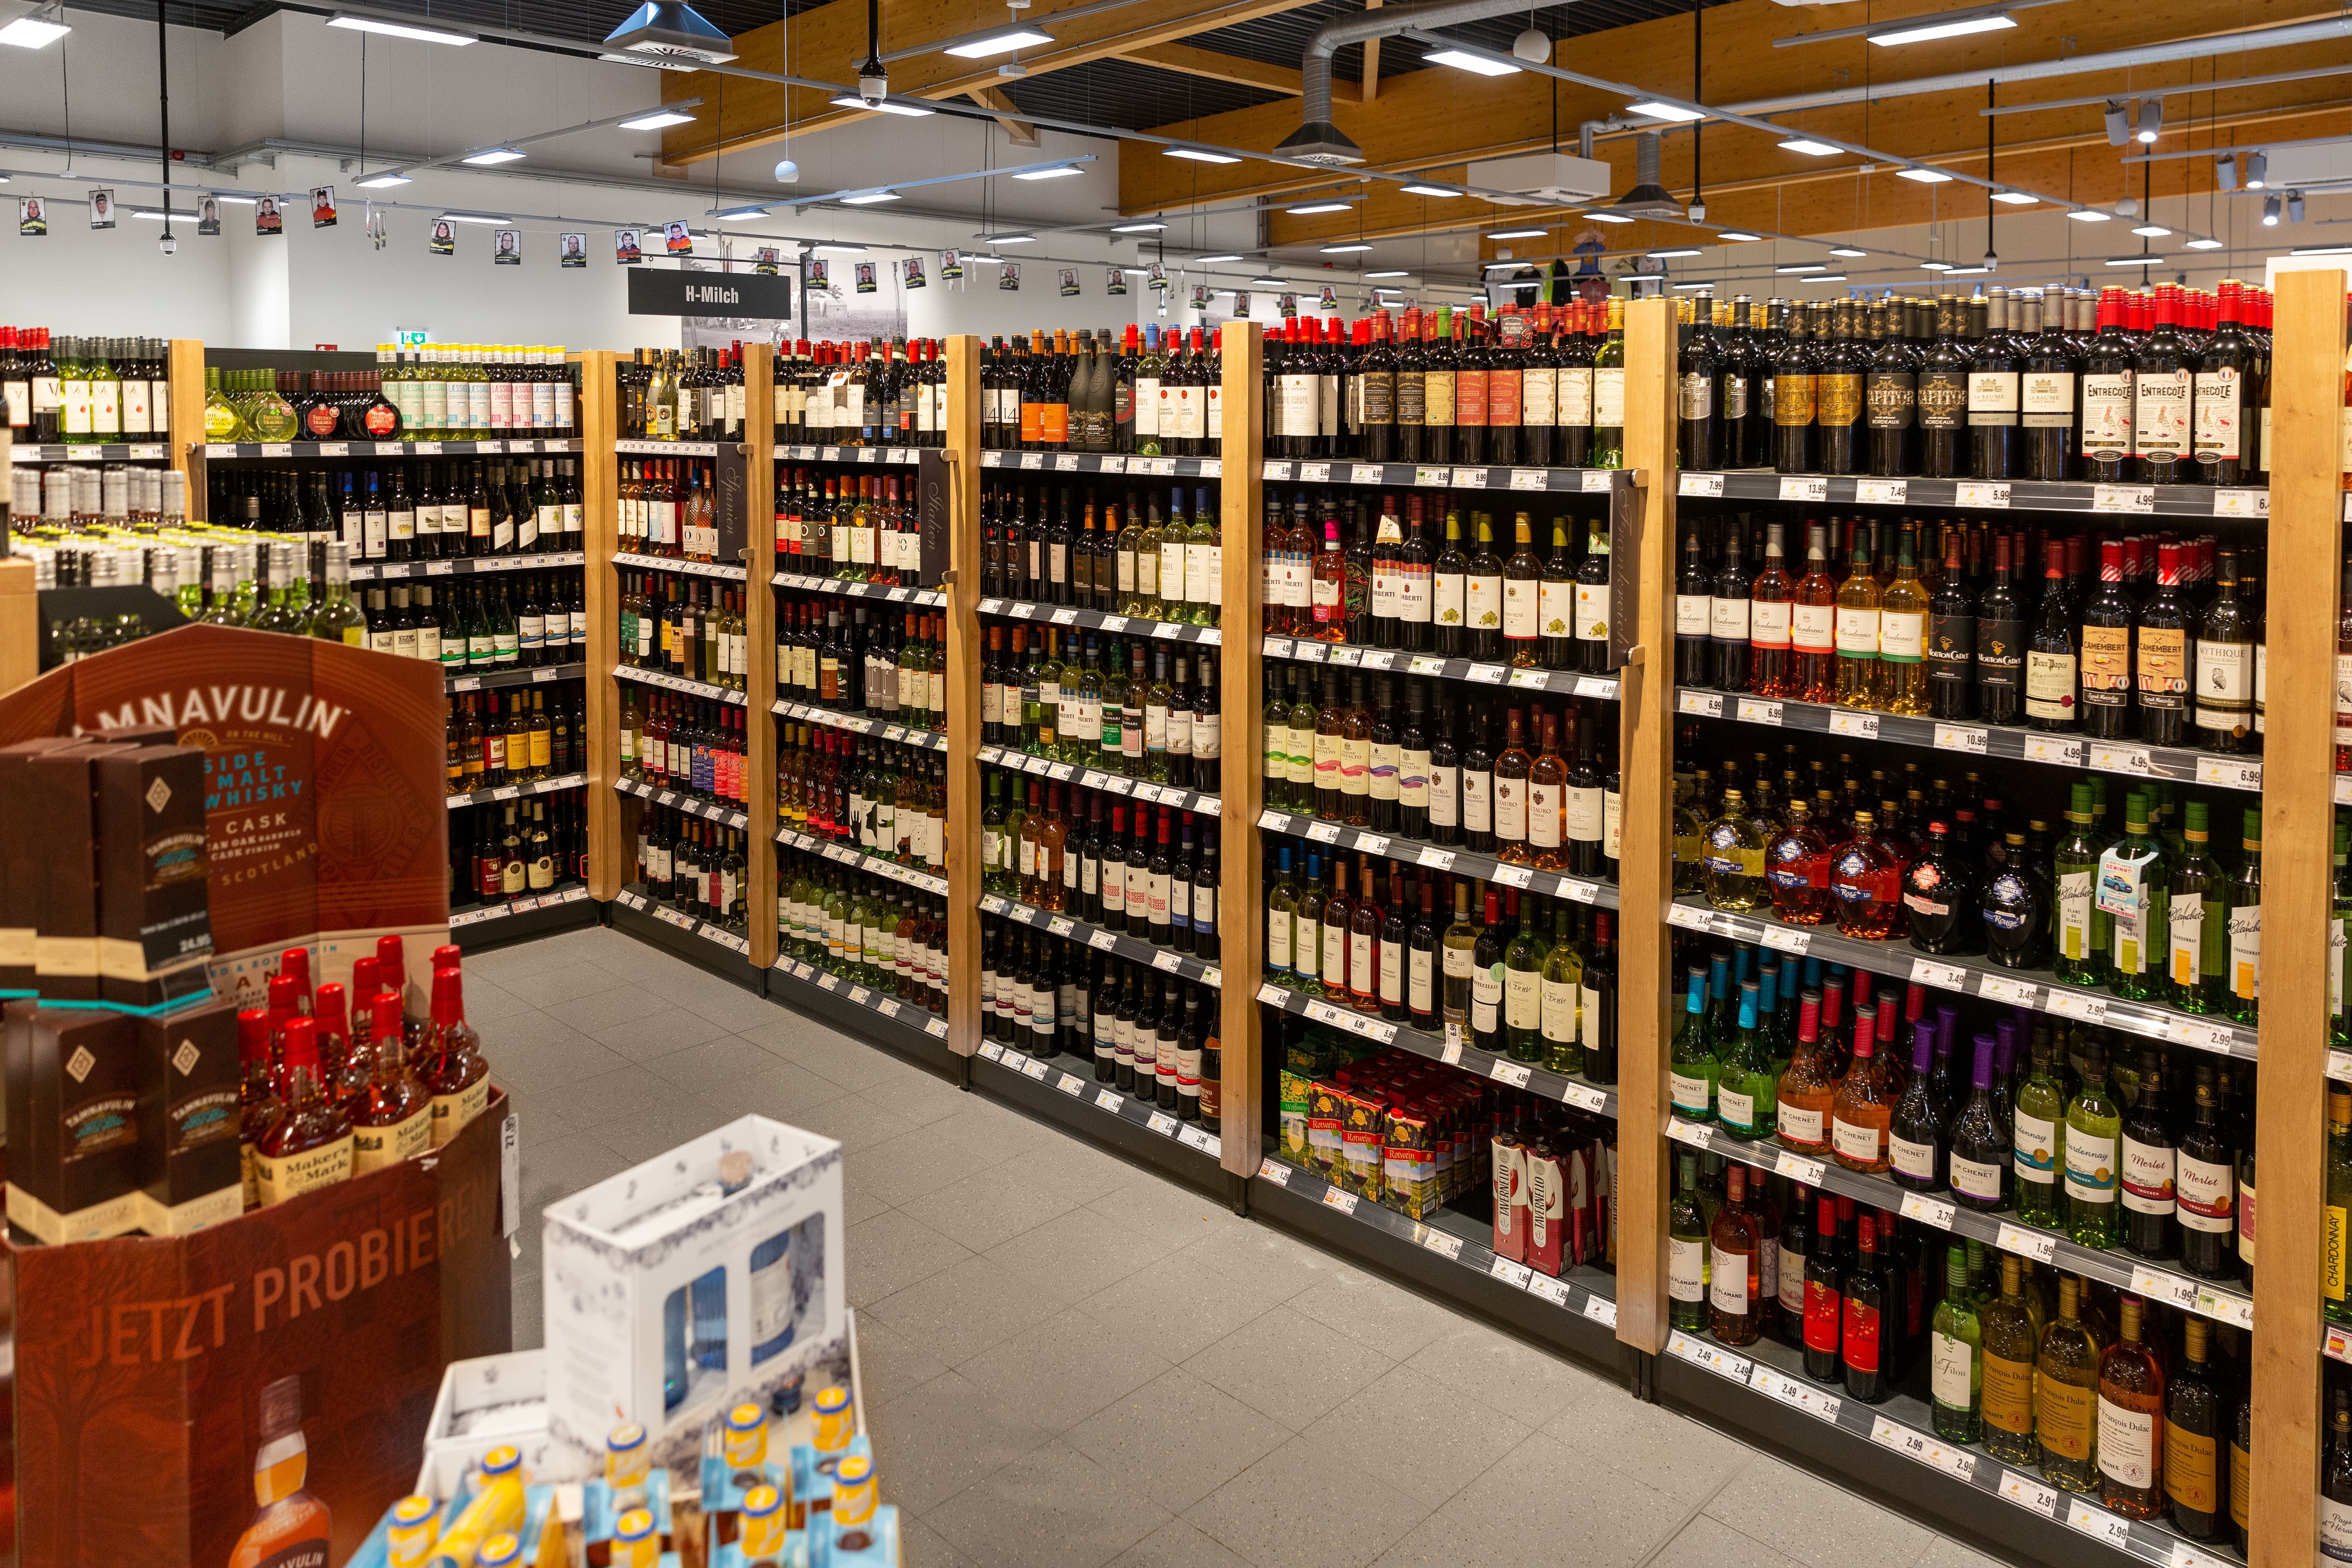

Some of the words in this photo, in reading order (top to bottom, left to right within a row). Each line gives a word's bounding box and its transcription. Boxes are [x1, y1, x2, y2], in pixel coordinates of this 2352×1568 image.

[686, 285, 739, 304] H-Milch
[1709, 481, 1722, 490] 7.99
[1809, 484, 1826, 493] 13.99
[1891, 487, 1905, 496] 7.49
[722, 467, 742, 536] Spanien
[2135, 496, 2153, 506] 4.99
[928, 482, 944, 552] Italien
[1713, 615, 1741, 626] Bordeaux
[1753, 620, 1783, 631] Bordeaux
[1795, 623, 1825, 635] Bordeaux
[1838, 628, 1872, 640] Bordeaux
[1883, 630, 1915, 643] Bordeaux
[2084, 641, 2125, 651] CAMEMBERT
[2140, 643, 2182, 653] CAMEMBERT
[1928, 648, 1949, 660] MOUTON
[1951, 650, 1969, 660] CADET
[2200, 647, 2245, 658] MYTHIQUE
[1979, 653, 2000, 665] MOUTON
[2001, 655, 2022, 664] CADET
[1534, 677, 1547, 686] 4.99
[1602, 685, 1614, 695] 6.99
[1709, 700, 1721, 710] 6.99
[73, 686, 343, 738] MNAVULIN
[1768, 708, 1781, 718] 6.99
[1863, 720, 1877, 731] 6.99
[1967, 734, 1986, 746] 10.99
[2064, 747, 2080, 759] 4.99
[2130, 756, 2147, 768] 4.99
[218, 766, 286, 789] MALT
[226, 813, 287, 835] CASK
[1442, 857, 1453, 865] 5.49
[1712, 860, 1731, 871] Blanc
[2106, 864, 2133, 875] GEWINNT!
[1518, 874, 1530, 883] 5.49
[1778, 875, 1794, 885] Rosé
[1916, 873, 1937, 882] MEDINET
[1581, 888, 1596, 898] 10.99
[1840, 888, 1857, 898] Rosé
[1996, 884, 2019, 893] MEDINET
[2058, 886, 2093, 901] Blanchet
[2169, 907, 2204, 922] Blanchet
[1698, 916, 1711, 926] 3.49
[1994, 915, 2017, 928] Rouge
[2228, 919, 2261, 936] Blanche
[1794, 938, 1808, 947] 3.49
[2172, 934, 2196, 943] CHARDONNAY
[2087, 1004, 2104, 1016] 2.99
[1354, 1020, 1365, 1029] 6.99
[1384, 1030, 1395, 1039] 5.99
[2211, 1033, 2230, 1046] 2.99
[1677, 1082, 1702, 1091] CHENET
[1590, 1096, 1603, 1106] 4.99
[1723, 1096, 1746, 1107] CHENET
[1285, 1103, 1308, 1112] Weißwein
[1789, 1114, 1816, 1123] CHENET
[1312, 1120, 1337, 1130] Rotwein
[1347, 1133, 1372, 1144] Rotwein
[1697, 1132, 1710, 1142] 3.79
[1844, 1130, 1871, 1141] CHENET
[1389, 1151, 1415, 1160] Rotwein
[1898, 1146, 1925, 1158] CHENET
[286, 1146, 349, 1175] Maker's
[1897, 1154, 1915, 1163] MERLOT
[2131, 1154, 2166, 1169] Merlot
[307, 1160, 348, 1183] Mark
[1279, 1171, 1289, 1180] 1.29
[1808, 1169, 1822, 1180] 3.79
[1963, 1167, 1993, 1178] CHENET
[2183, 1168, 2218, 1186] Merlot
[1961, 1176, 1983, 1185] MERLOT
[2072, 1173, 2091, 1183] TROCKEN
[1500, 1165, 1509, 1217] TAVERNELLO
[1346, 1200, 1356, 1210] 1.29
[1534, 1177, 1545, 1229] TAVERNELLO
[2189, 1203, 2211, 1213] TROCKEN
[2037, 1242, 2053, 1256] 1.99
[2327, 1214, 2338, 1287] CHARDONNAY
[1518, 1273, 1529, 1282] 1.99
[1674, 1277, 1698, 1286] FLAMAND
[1718, 1288, 1742, 1298] FLAMAND
[2174, 1287, 2192, 1301] 1.99
[2200, 1300, 2213, 1312] BIO
[79, 1284, 234, 1367] JETZT
[1734, 1363, 1748, 1376] 2.49
[2012, 1371, 2031, 1381] Dulac
[1782, 1384, 1796, 1397] 2.49
[2041, 1383, 2065, 1401] François
[2066, 1396, 2087, 1406] Dulac
[2101, 1408, 2128, 1429] François
[2130, 1421, 2150, 1433] Dulac
[1907, 1436, 1923, 1451] 2.99
[2191, 1444, 2212, 1457] Dulac
[2101, 1459, 2120, 1471] FRANCE
[2037, 1493, 2055, 1509] 2.91
[2108, 1523, 2127, 1540] 2.99
